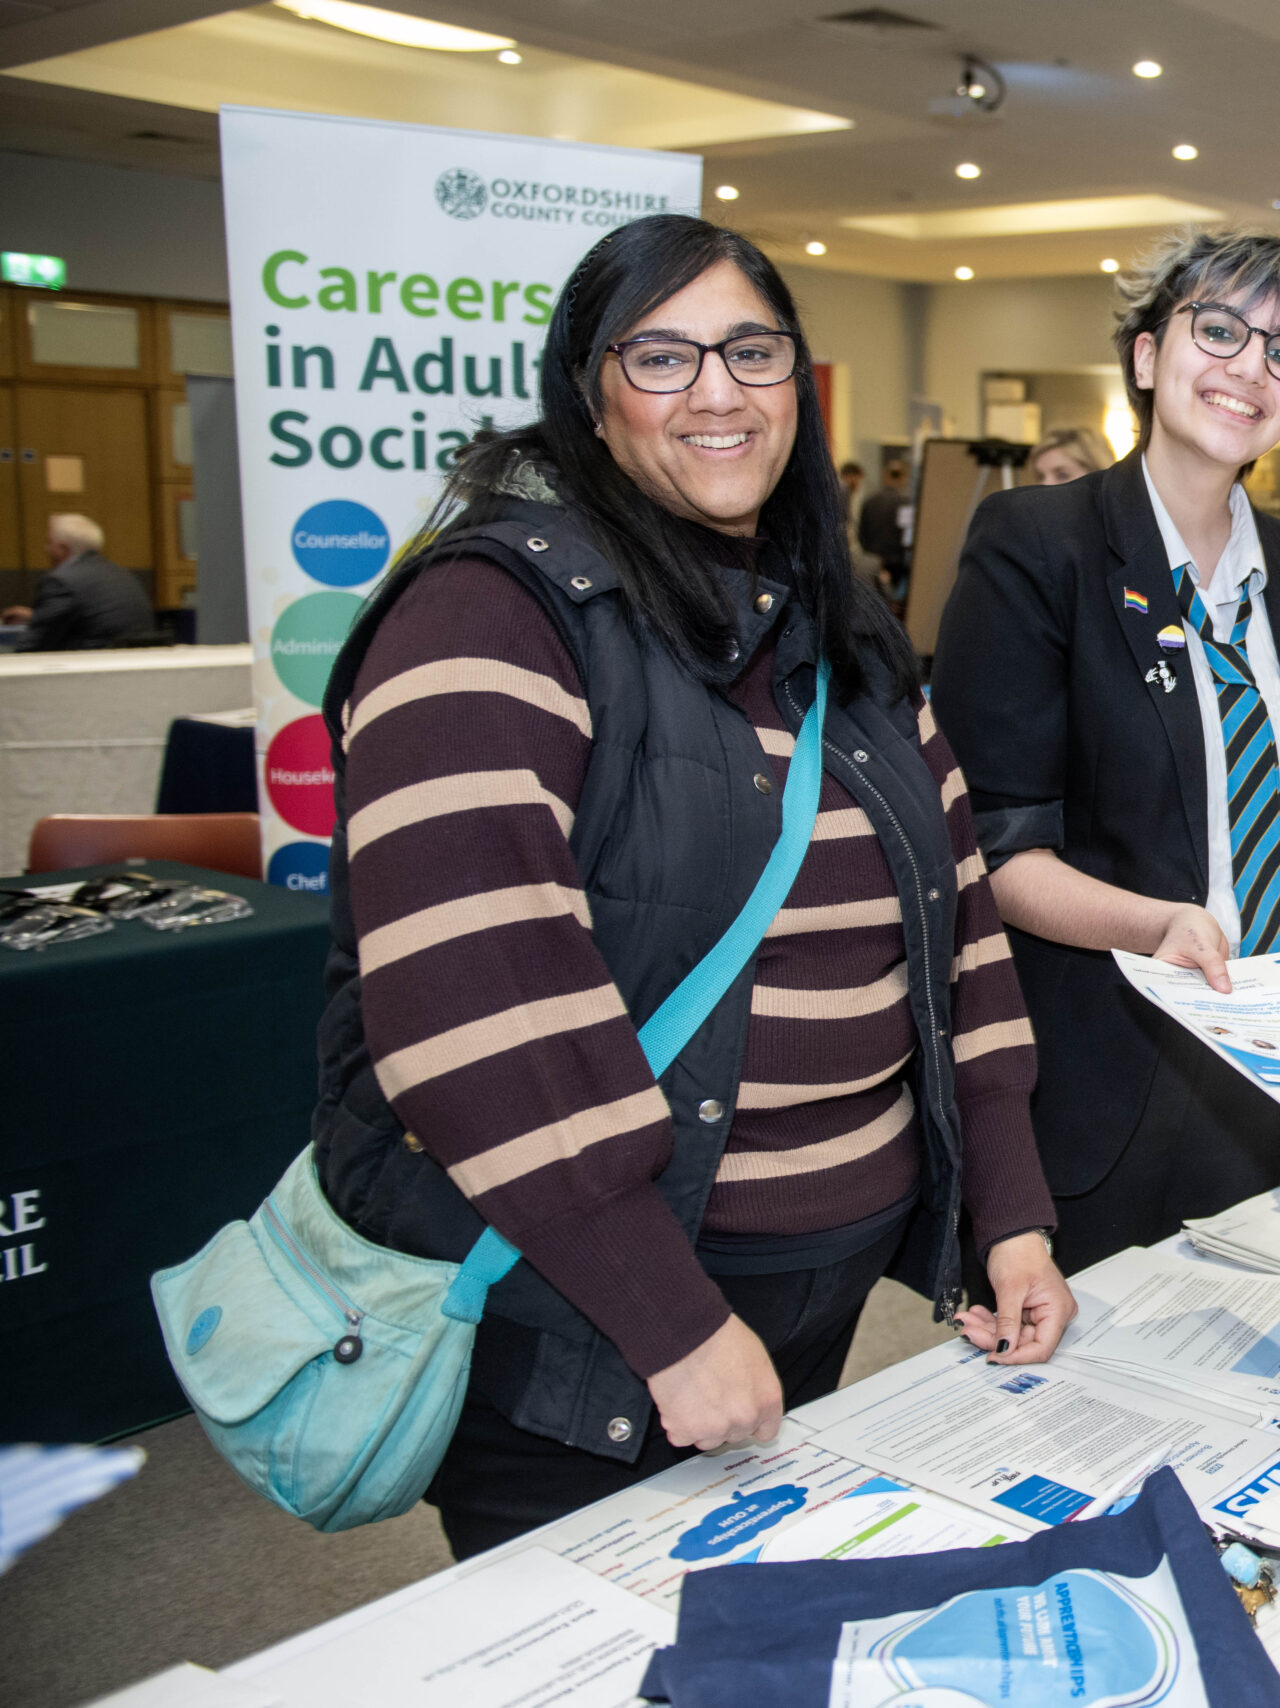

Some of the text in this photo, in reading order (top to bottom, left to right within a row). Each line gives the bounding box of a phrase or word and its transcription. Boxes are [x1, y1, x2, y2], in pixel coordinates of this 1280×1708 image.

[490, 178, 670, 211] OXFORDSHIRE
[490, 202, 634, 228] COUNTY COU
[261, 250, 553, 325] Careers
[265, 325, 336, 390] in
[268, 410, 495, 471] Socia
[295, 531, 386, 550] Counsellor
[273, 639, 345, 657] Adminis
[286, 873, 327, 891] Chef
[706, 1493, 793, 1548] Apprenticeships
[717, 1501, 759, 1529] at OUH
